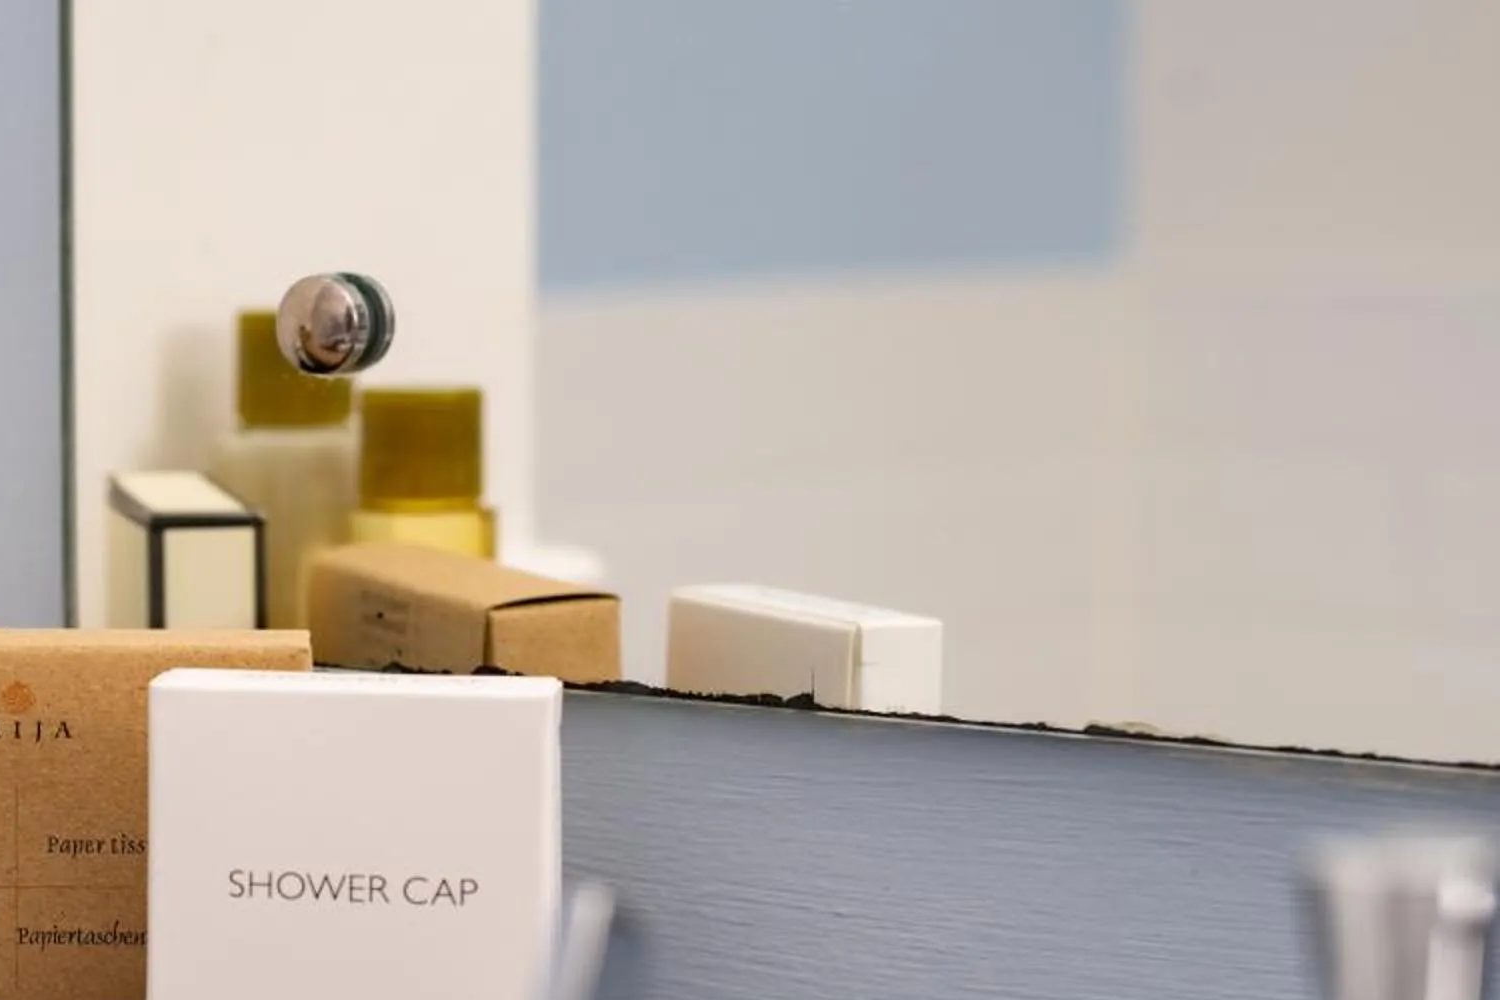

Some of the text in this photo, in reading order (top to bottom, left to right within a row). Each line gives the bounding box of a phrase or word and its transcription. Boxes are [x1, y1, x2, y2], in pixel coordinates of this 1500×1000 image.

[47, 835, 105, 858] Paper
[228, 869, 479, 907] SHOWER CAP
